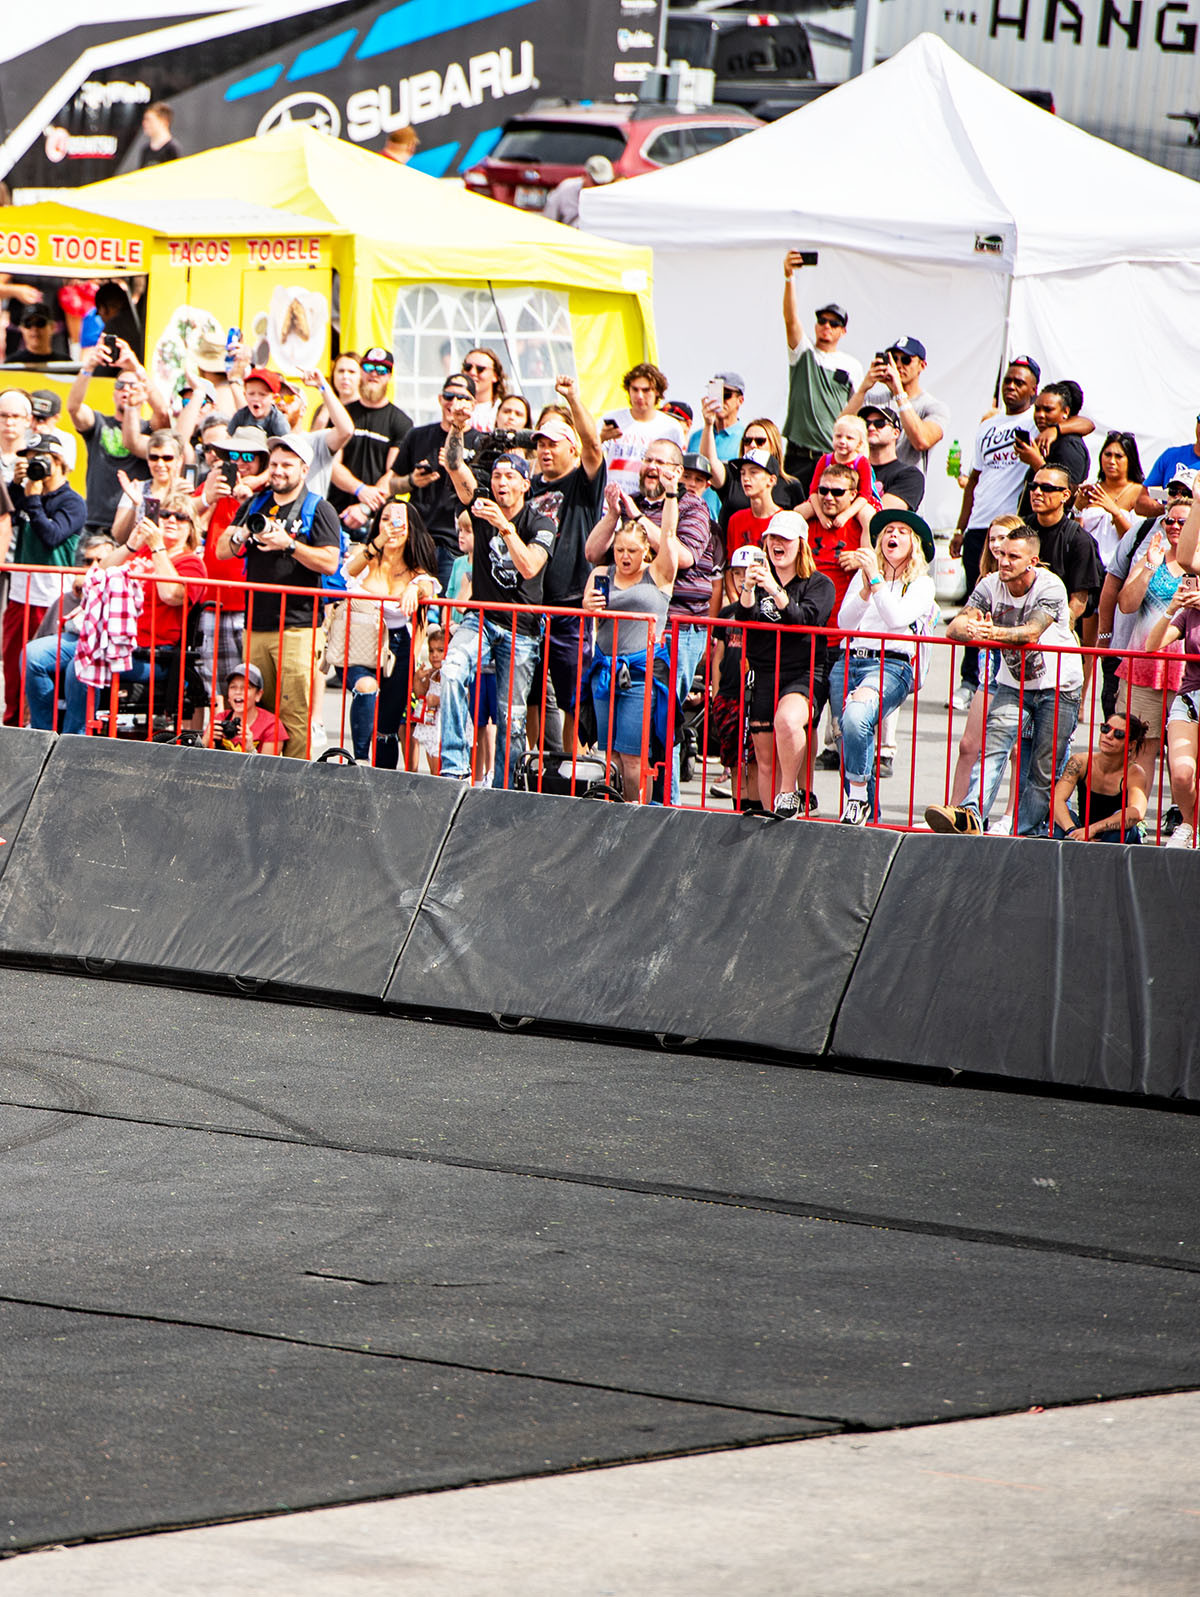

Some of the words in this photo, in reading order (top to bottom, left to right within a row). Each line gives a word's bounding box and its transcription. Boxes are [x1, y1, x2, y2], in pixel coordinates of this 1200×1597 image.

[944, 9, 977, 25] THE
[989, 0, 1199, 55] HANG
[346, 39, 535, 142] SUBARU
[52, 236, 141, 264] TOOELE
[168, 240, 230, 264] TACOS
[247, 237, 321, 261] TOOELE
[740, 551, 749, 561] T
